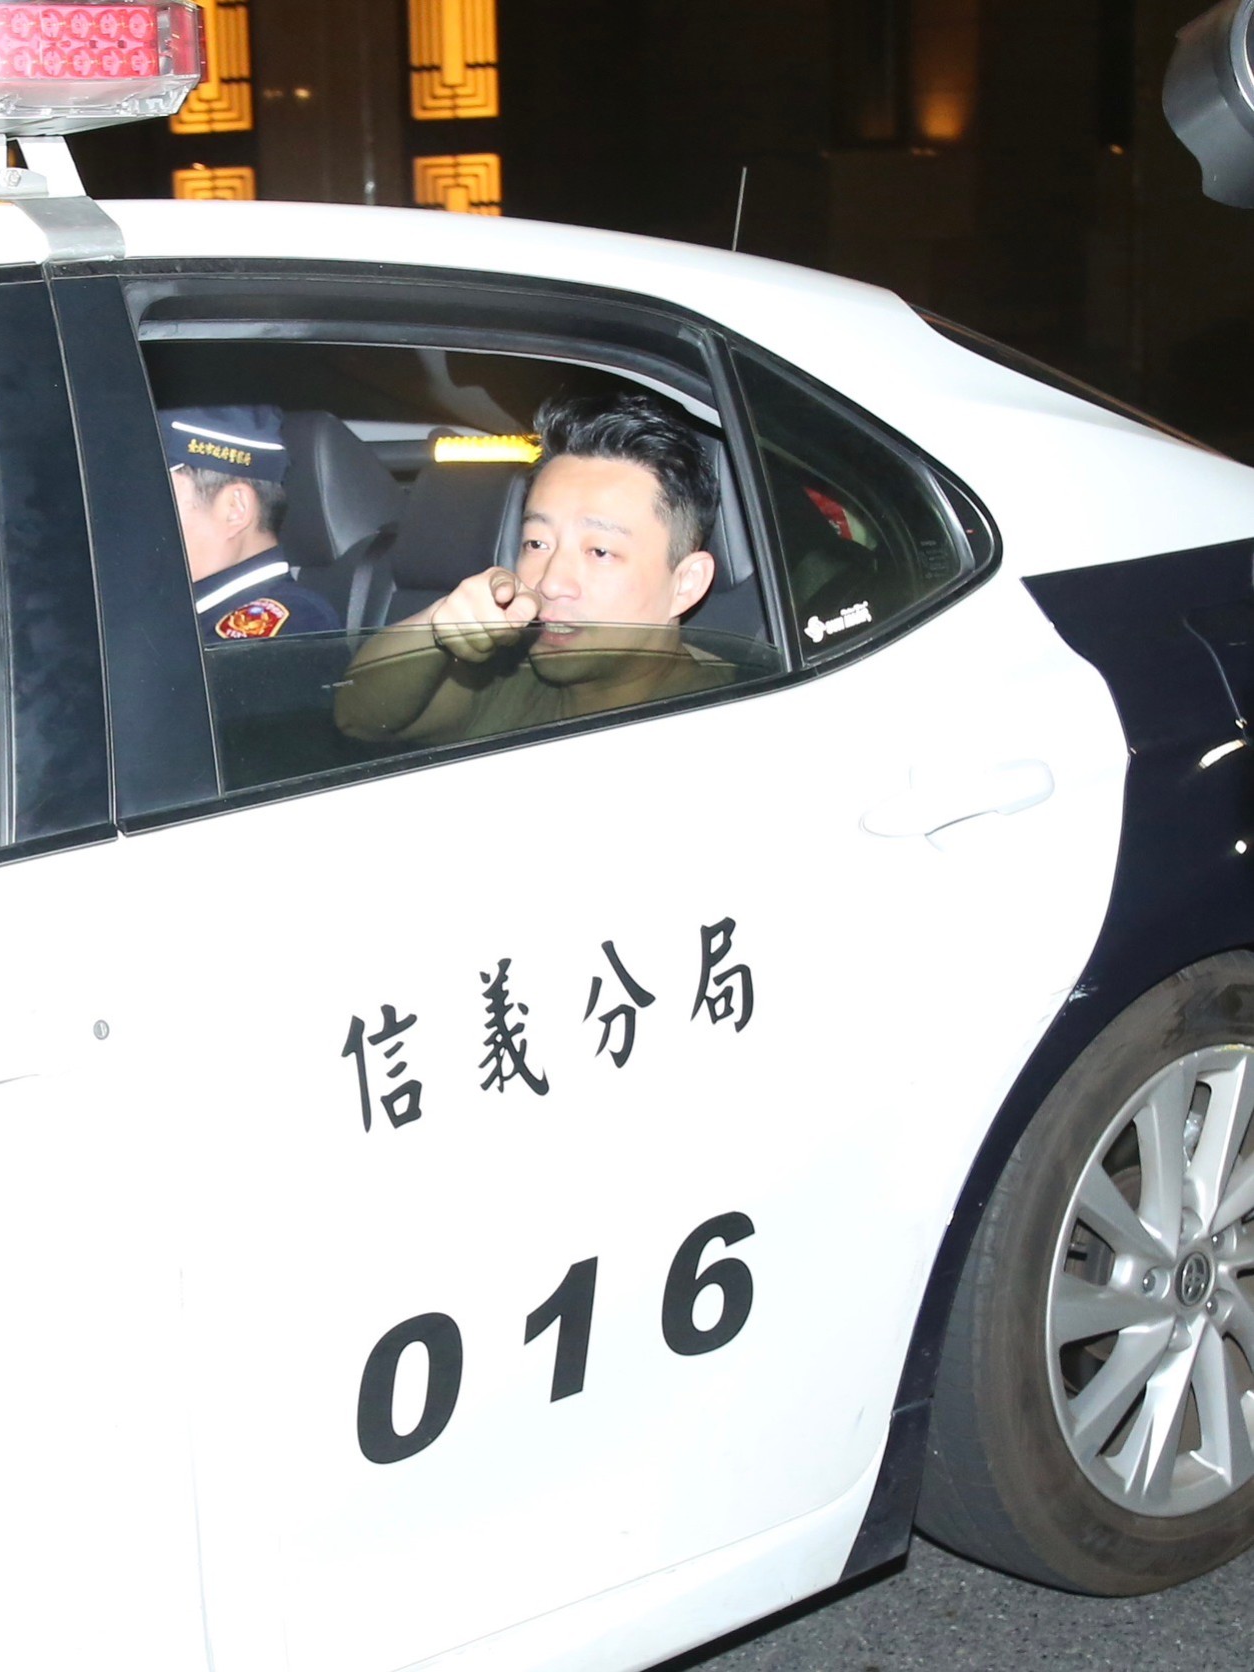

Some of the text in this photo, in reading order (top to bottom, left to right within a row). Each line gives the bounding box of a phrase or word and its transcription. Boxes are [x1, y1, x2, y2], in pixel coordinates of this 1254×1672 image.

[342, 917, 754, 1133] 信義分局
[357, 1212, 755, 1465] 016
